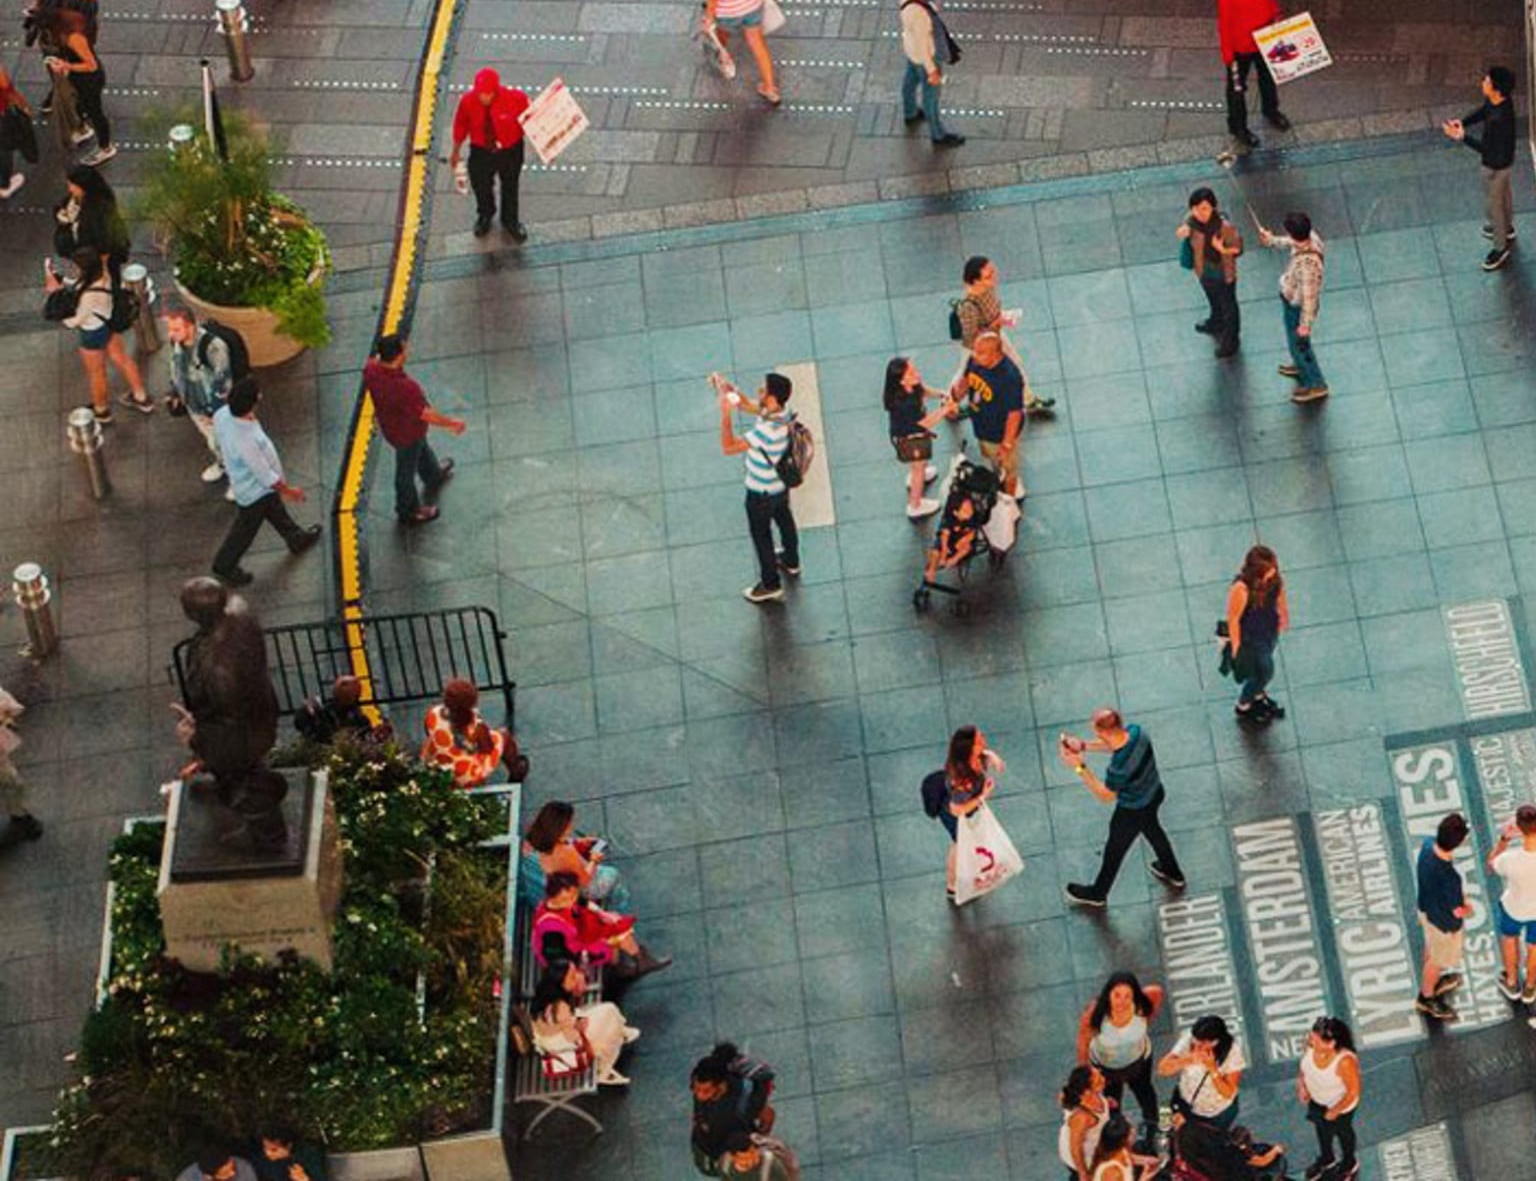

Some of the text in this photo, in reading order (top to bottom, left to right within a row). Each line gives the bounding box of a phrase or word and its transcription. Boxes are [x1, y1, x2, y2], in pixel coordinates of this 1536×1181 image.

[1448, 601, 1532, 718] HIRSCHFELD
[1319, 809, 1366, 919] AMERICAN
[1352, 804, 1397, 915] AIRLINES
[1233, 817, 1329, 1060] NE AMSTERDAM
[1341, 921, 1423, 1046] LYRIC
[1464, 931, 1512, 1023] HAYES
